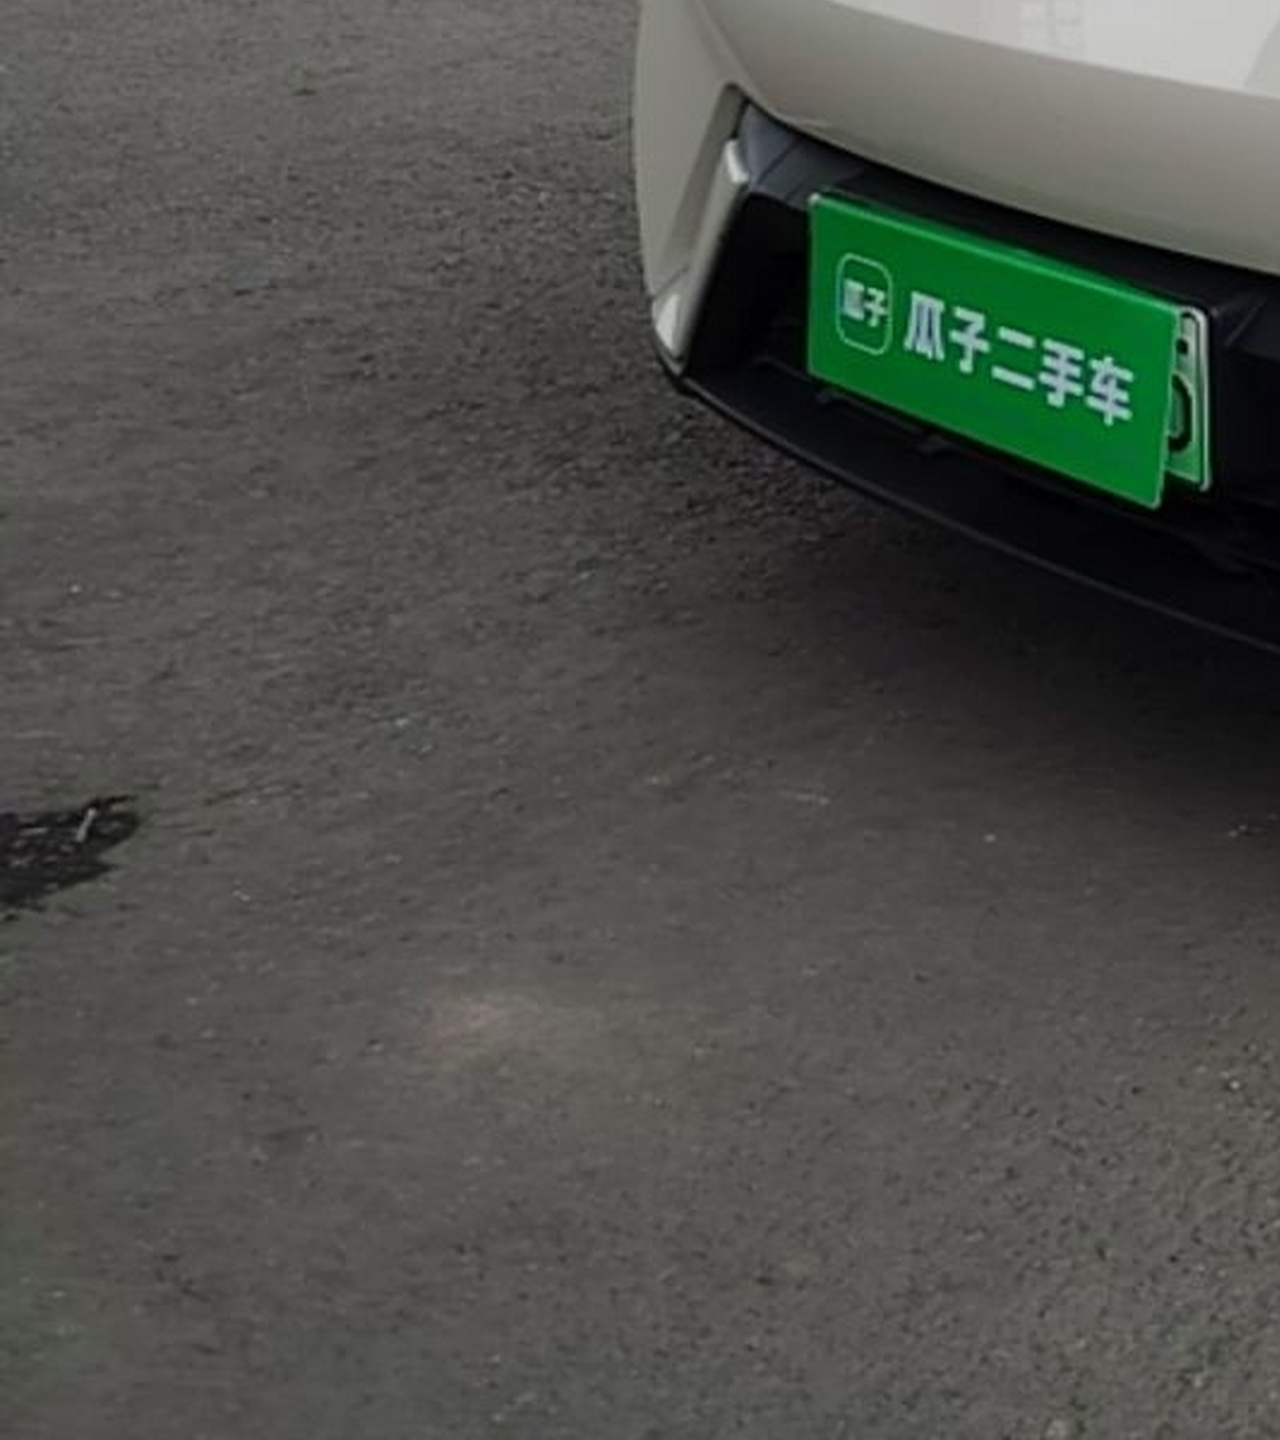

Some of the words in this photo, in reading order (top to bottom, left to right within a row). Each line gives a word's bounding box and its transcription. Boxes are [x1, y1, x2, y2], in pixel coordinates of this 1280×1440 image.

[904, 291, 1134, 425] 瓜子二手车
